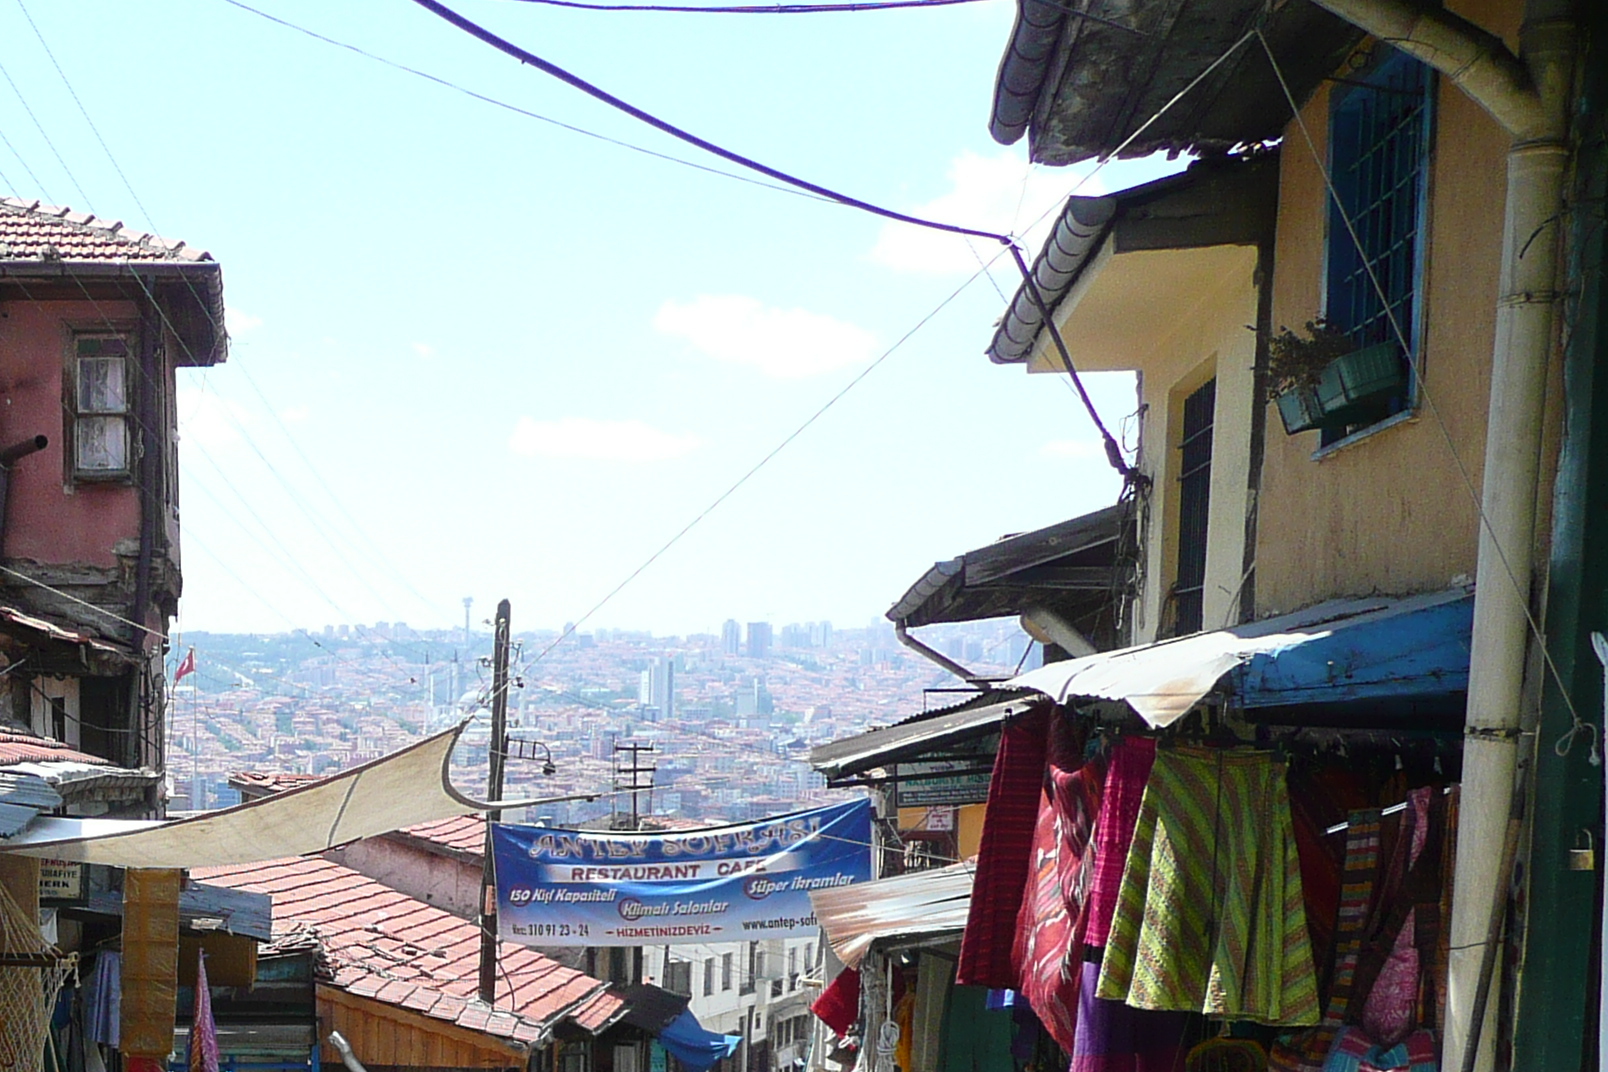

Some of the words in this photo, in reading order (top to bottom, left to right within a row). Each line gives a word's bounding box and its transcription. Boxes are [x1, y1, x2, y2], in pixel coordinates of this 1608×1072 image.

[529, 832, 649, 861] ANTEP
[664, 818, 823, 858] SOFRASI
[572, 863, 702, 882] RESTAURANT
[717, 858, 768, 878] CAFE
[750, 879, 789, 895] Süper
[510, 889, 532, 902] 150
[555, 888, 618, 904] Kapasiteli
[672, 898, 729, 914] Salonlar
[528, 924, 544, 936] 310
[546, 924, 556, 936] 91
[559, 924, 570, 936] 23
[579, 924, 589, 937] 24
